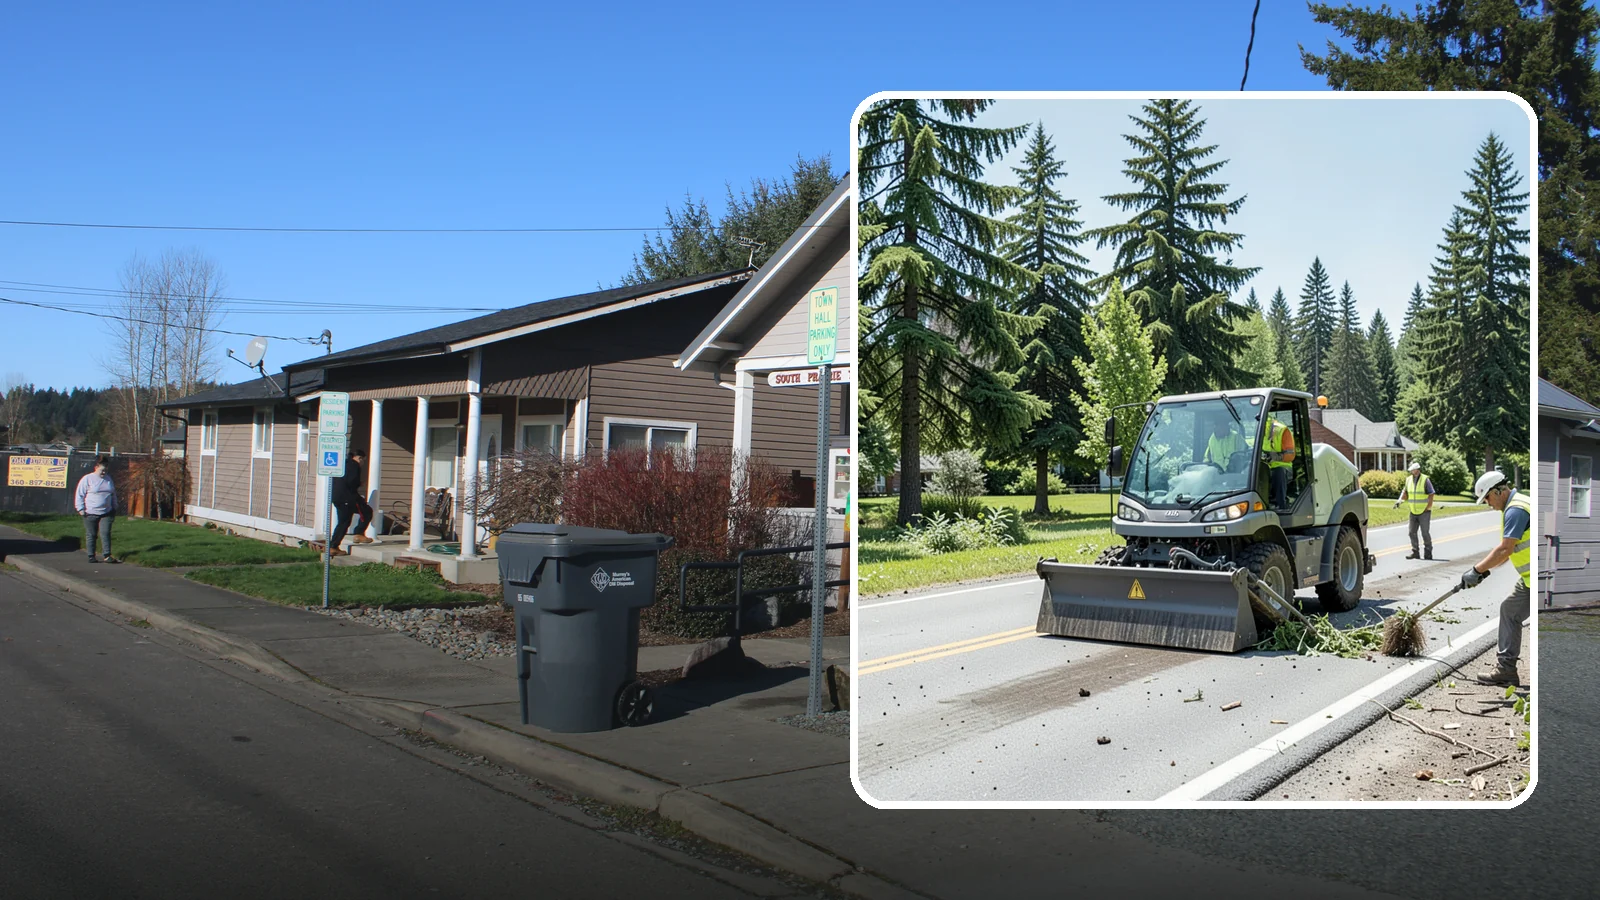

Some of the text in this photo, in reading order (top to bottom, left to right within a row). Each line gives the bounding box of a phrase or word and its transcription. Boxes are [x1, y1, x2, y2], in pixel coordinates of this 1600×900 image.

[815, 295, 833, 308] TOWN
[815, 312, 831, 325] HALL
[810, 327, 836, 341] PARKING
[813, 344, 831, 357] ONLY
[775, 374, 801, 384] SOUTH
[808, 371, 841, 382] PRIE
